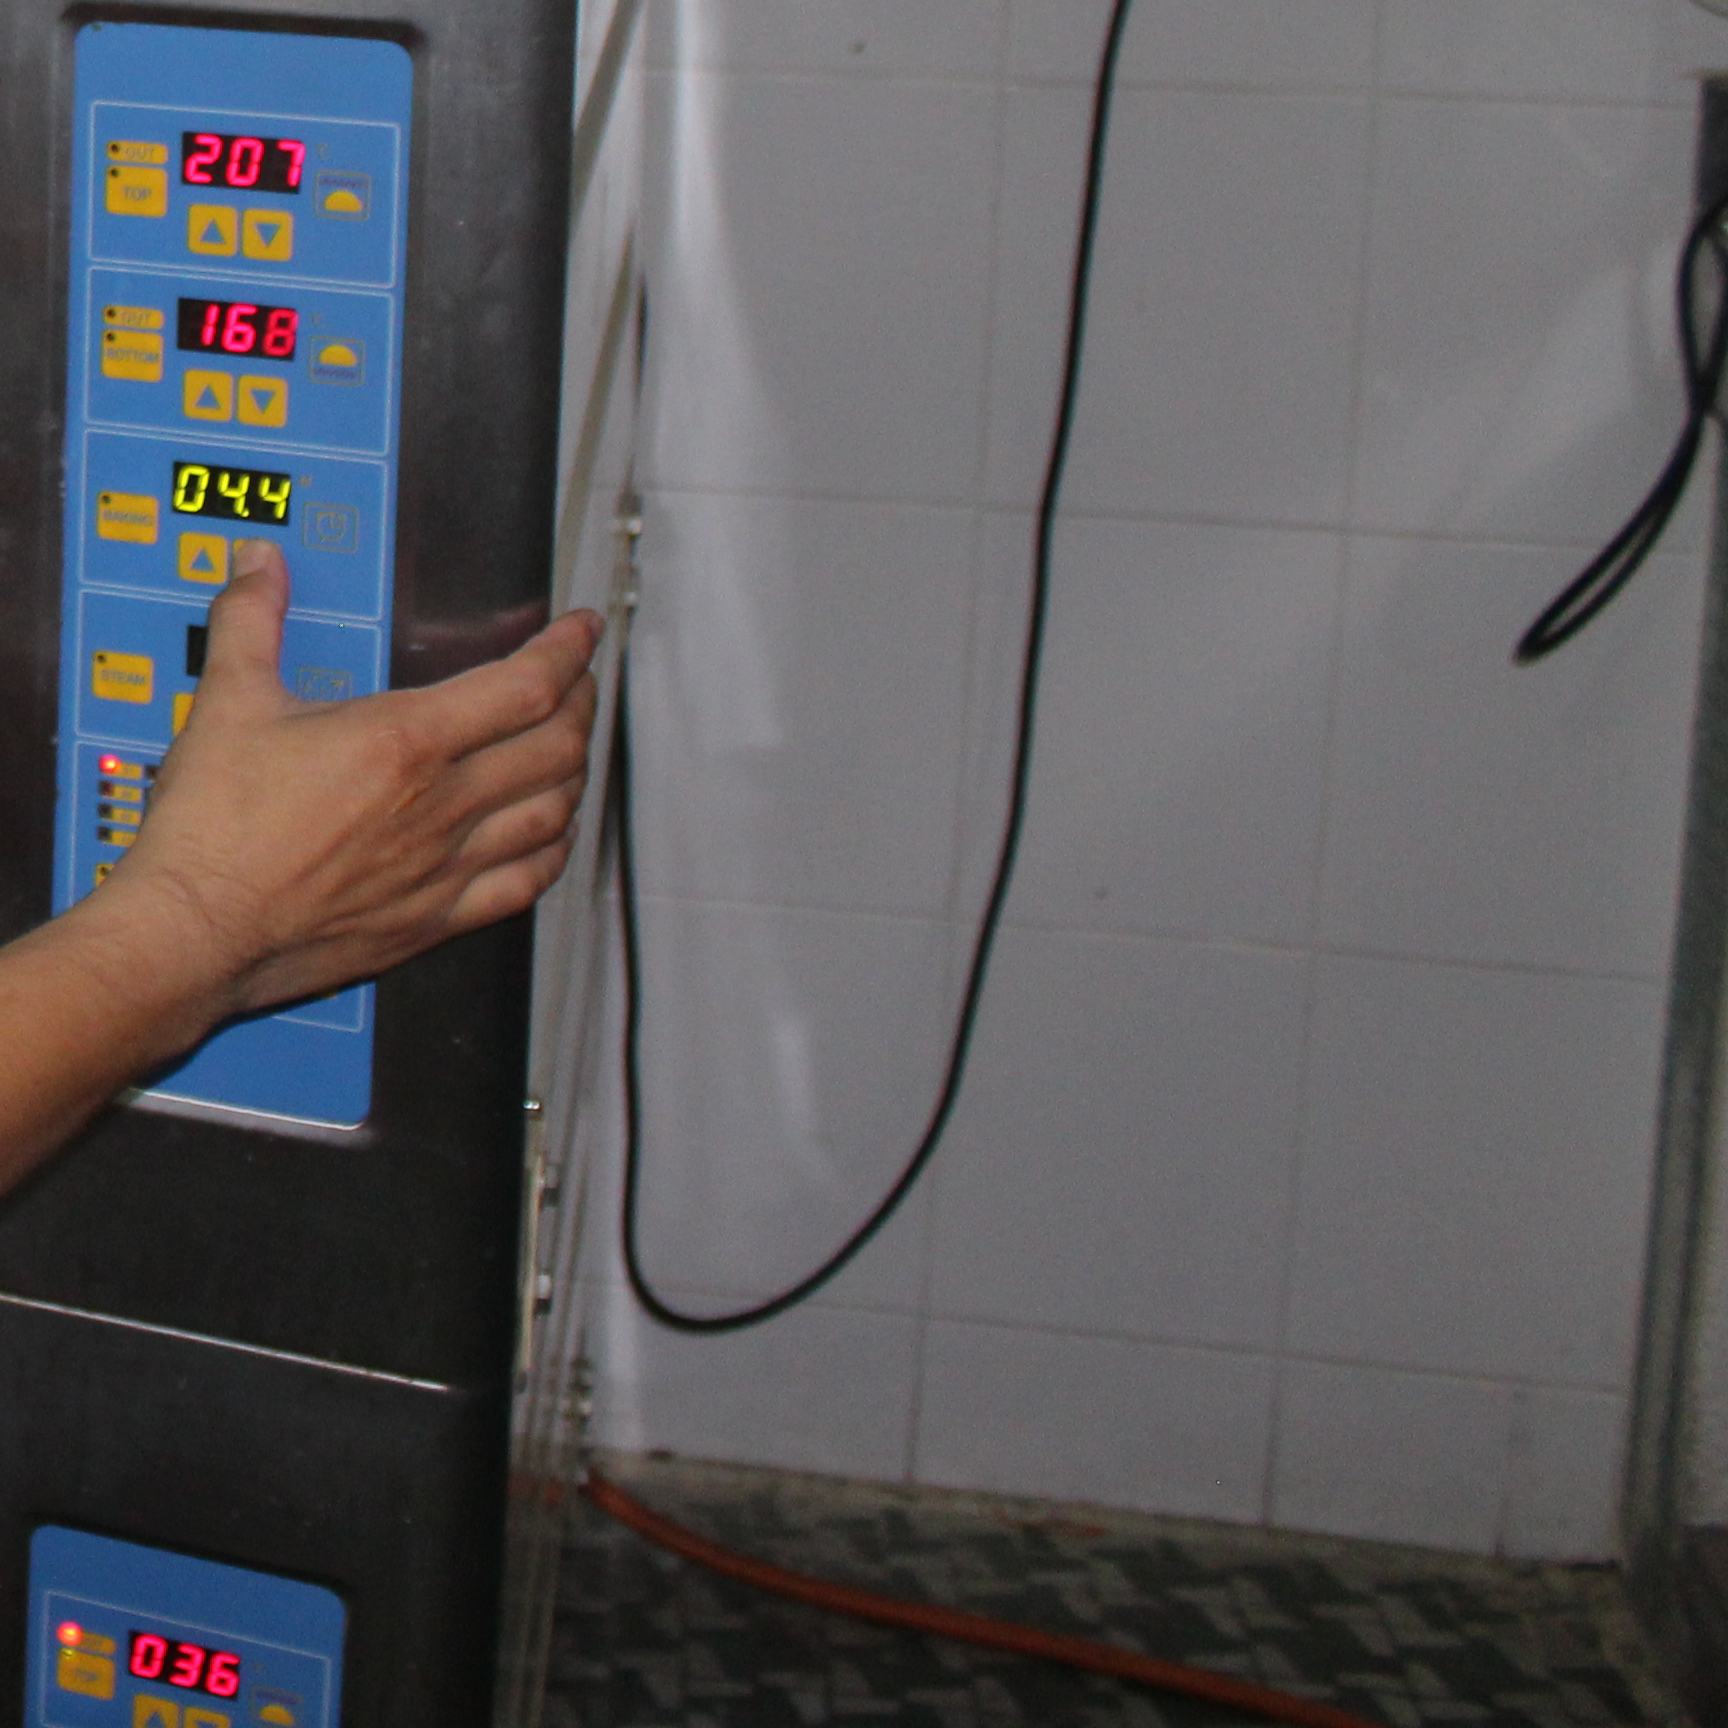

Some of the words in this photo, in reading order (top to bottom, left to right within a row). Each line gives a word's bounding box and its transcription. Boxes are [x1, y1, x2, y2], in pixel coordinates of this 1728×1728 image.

[184, 133, 307, 187] 207
[200, 302, 300, 357] 168
[175, 466, 291, 519] 04.4
[130, 1633, 241, 1697] 036
